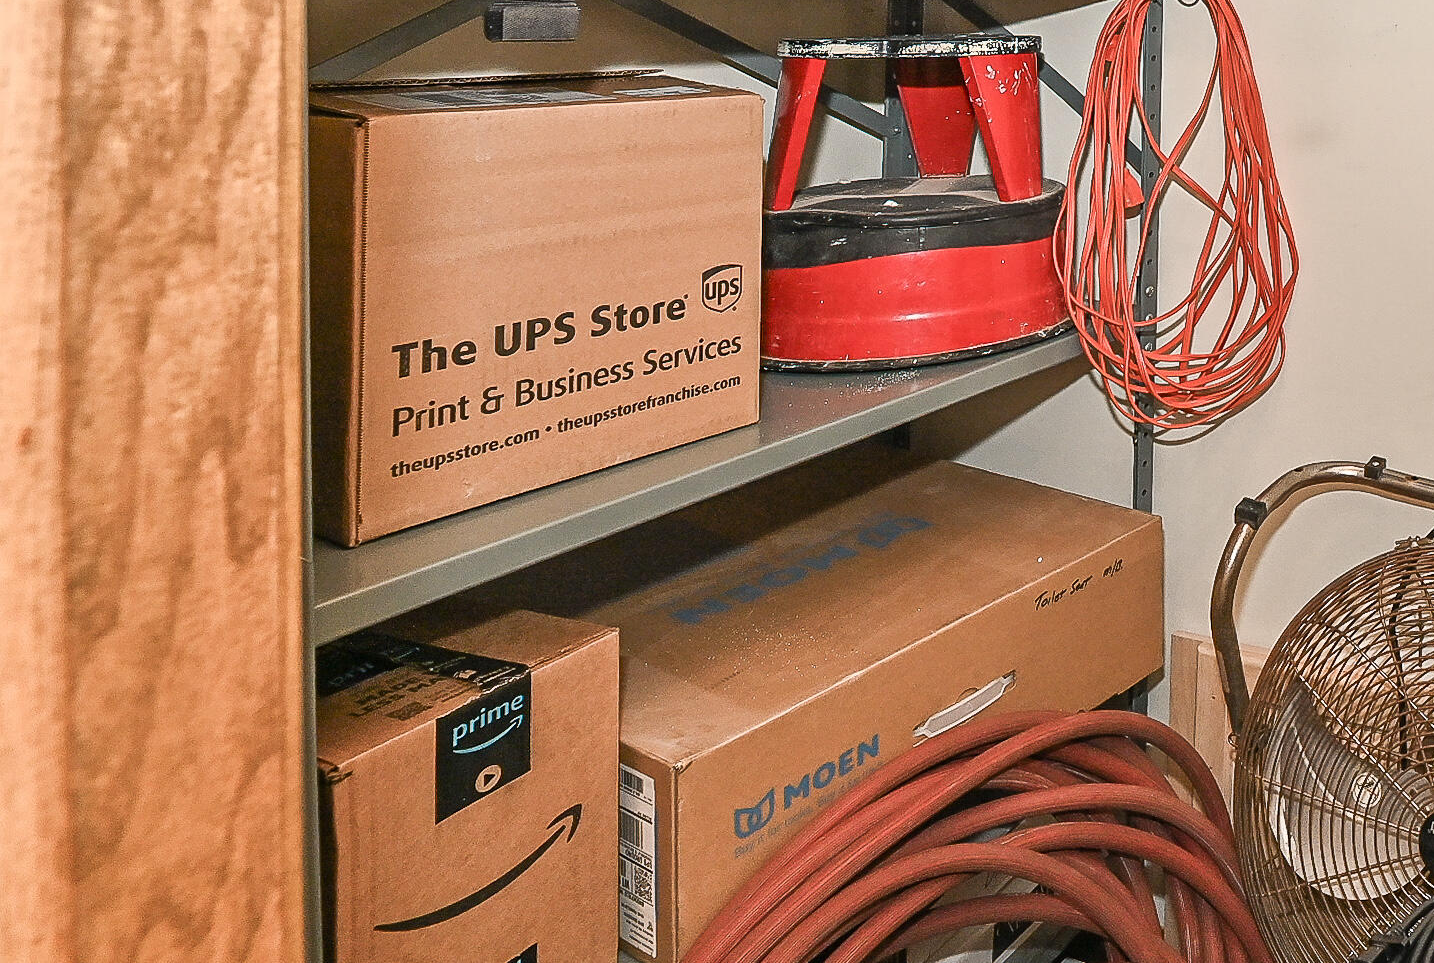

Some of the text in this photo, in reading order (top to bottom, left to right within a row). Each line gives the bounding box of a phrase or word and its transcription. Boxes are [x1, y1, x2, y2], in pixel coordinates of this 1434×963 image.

[704, 278, 739, 305] ups
[392, 297, 687, 378] The UPS Store
[392, 335, 742, 437] Print & Business Services
[390, 375, 741, 478] theupsstore.com theupsstorefranchise.com
[452, 694, 524, 747] prime
[784, 733, 879, 810] MOEN
